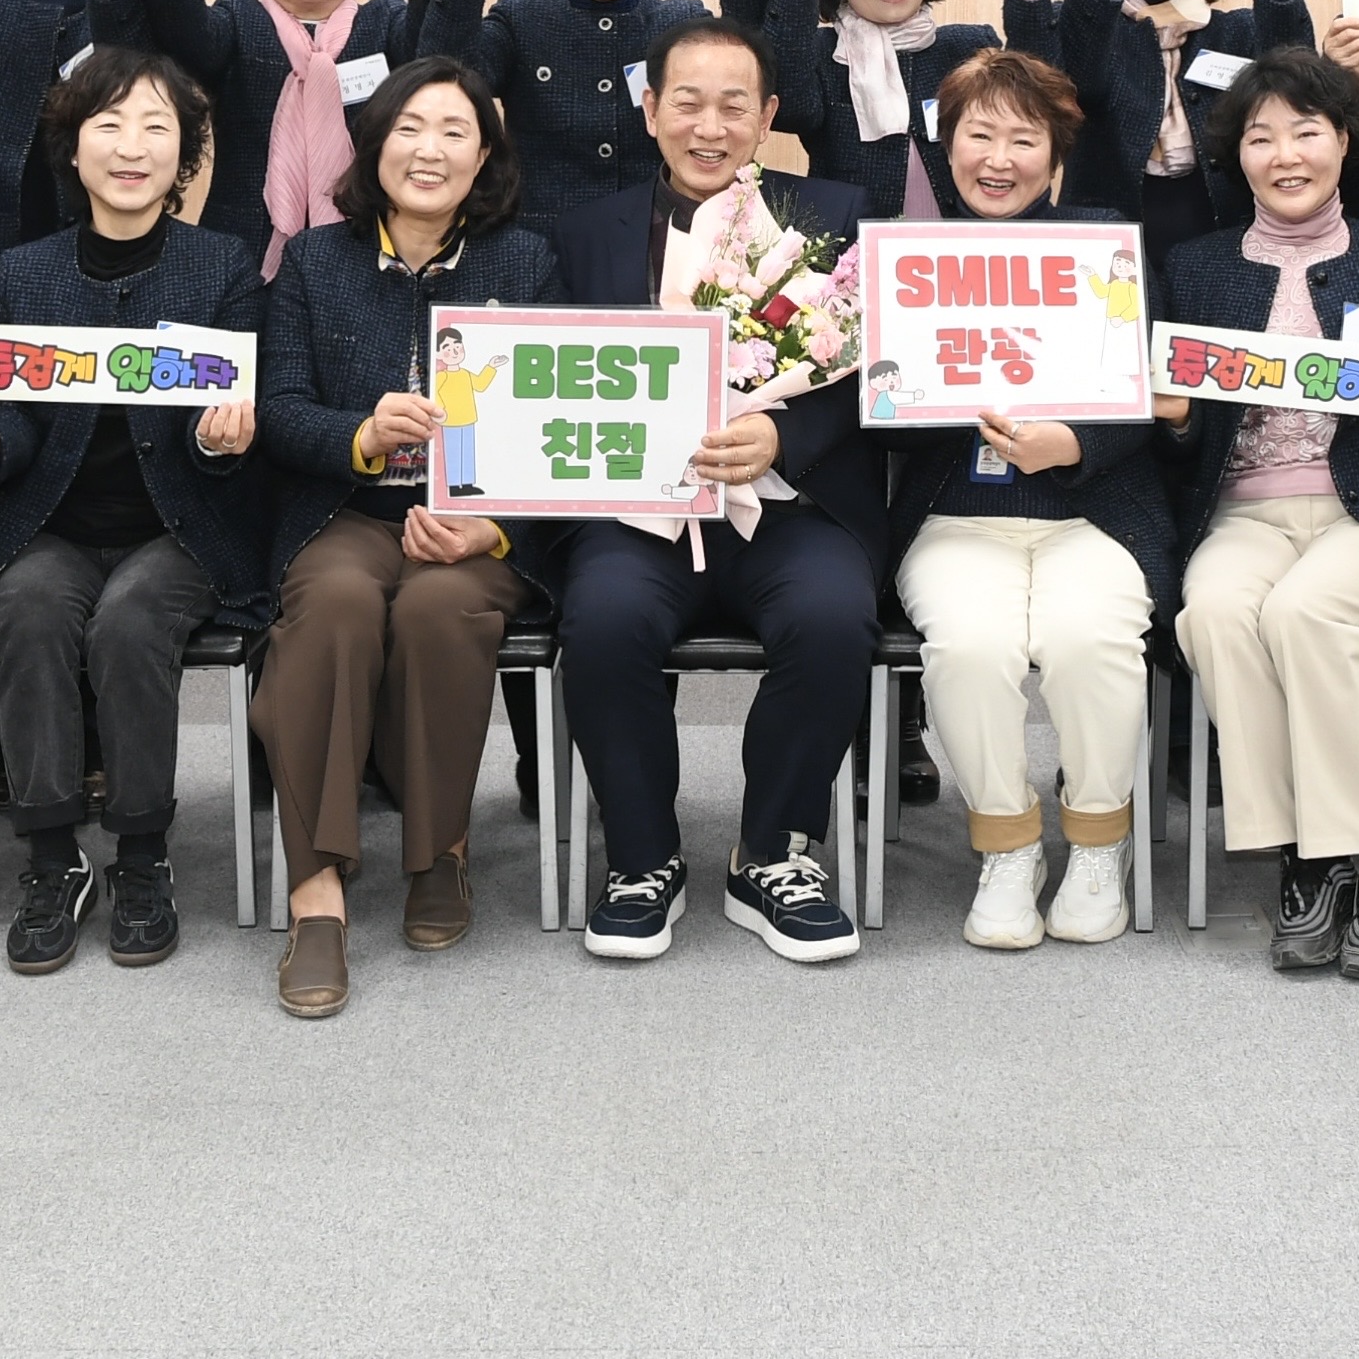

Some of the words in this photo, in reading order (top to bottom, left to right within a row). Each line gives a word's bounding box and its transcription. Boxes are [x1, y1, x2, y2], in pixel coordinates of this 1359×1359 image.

[895, 255, 1077, 307] SMILE
[108, 343, 239, 393] 일하자
[513, 343, 679, 401] BEST
[1167, 336, 1285, 390] 즐겁게
[541, 418, 647, 480] 친절
